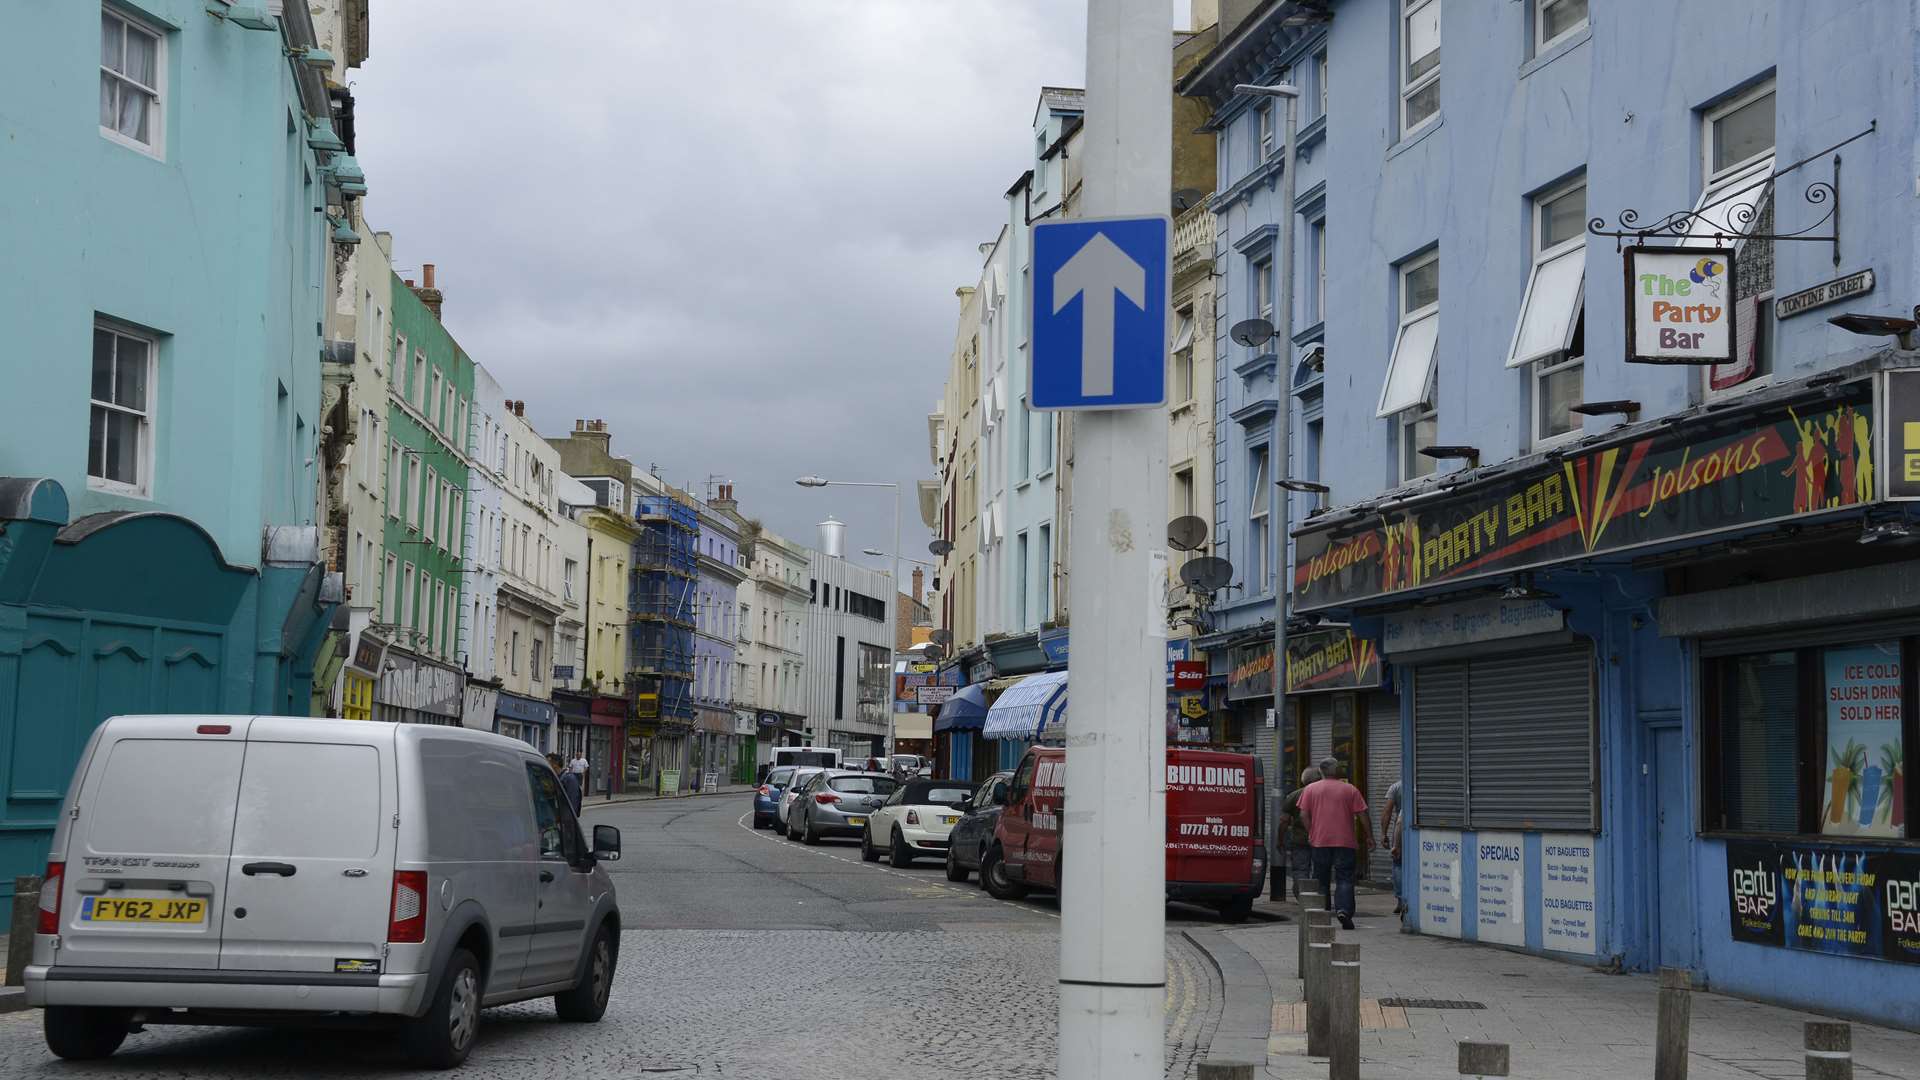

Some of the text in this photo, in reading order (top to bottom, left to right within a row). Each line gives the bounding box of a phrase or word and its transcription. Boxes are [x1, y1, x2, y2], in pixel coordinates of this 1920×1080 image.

[1640, 274, 1692, 296] The
[1782, 275, 1866, 315] TONTINE STREET
[1652, 301, 1722, 324] Party
[1660, 328, 1705, 349] Bar
[1639, 436, 1767, 518] Jolsons
[1301, 471, 1565, 595] Jolsons PARTY BAR
[1453, 613, 1490, 632] Burgers
[1501, 600, 1554, 625] Baguettes
[1168, 647, 1185, 662] News
[1292, 650, 1325, 685] PARTY
[1326, 639, 1348, 669] BAR
[1845, 664, 1900, 680] ICE COLD
[1830, 685, 1903, 701] SLUSH DRIN
[1841, 705, 1903, 721] SOLD HER
[1167, 765, 1247, 788] BUILDING
[1197, 785, 1248, 795] MAINTENANCE
[1180, 823, 1250, 837] 07776 471 099
[1480, 845, 1520, 862] SPECIALS
[1545, 847, 1590, 858] HOT BAGUETTES
[1733, 860, 1777, 905] party
[1544, 898, 1593, 911] COLD BAGUETTES
[1886, 870, 1920, 918] par
[97, 900, 202, 920] FY62 JXP
[1737, 895, 1768, 917] BAR
[1890, 909, 1920, 932] BA
